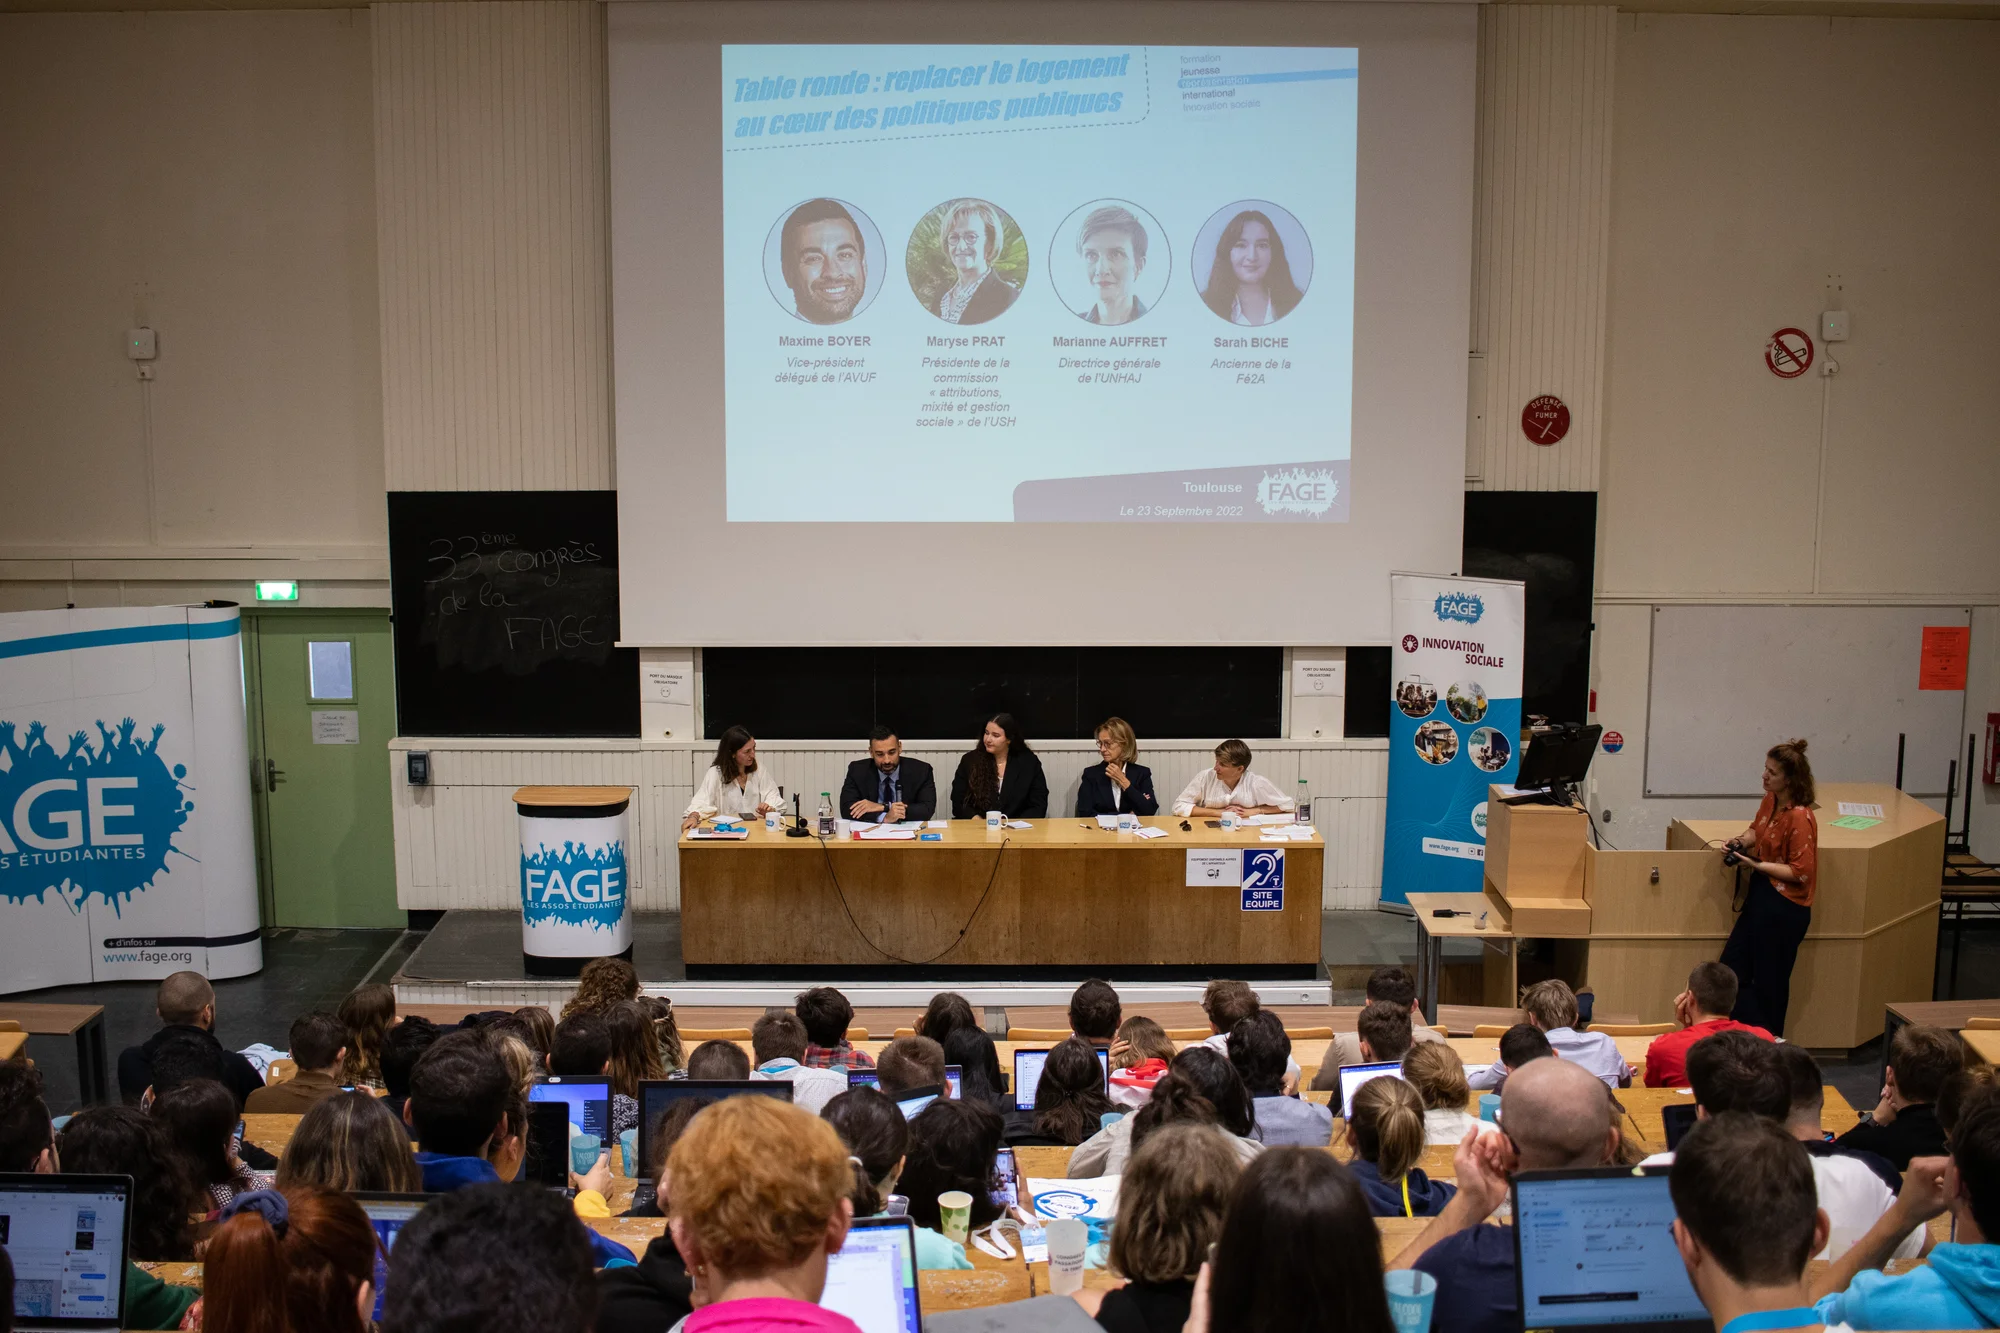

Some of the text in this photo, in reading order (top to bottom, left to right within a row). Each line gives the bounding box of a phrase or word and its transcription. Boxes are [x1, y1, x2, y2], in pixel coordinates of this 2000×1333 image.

[1180, 53, 1221, 64] formation
[734, 75, 797, 103] Table
[800, 70, 870, 98] ronde
[884, 64, 987, 93] replacer
[989, 61, 1013, 85] le
[1016, 53, 1130, 84] logement
[1180, 67, 1220, 78] jeunesse
[1182, 89, 1236, 100] international
[1230, 100, 1261, 110] sociale
[734, 91, 1124, 138] au cœur des politiques publiques
[779, 336, 872, 346] Maxime BOYER
[927, 336, 1005, 349] Maryse PRAT
[1053, 336, 1167, 347] Marianne AUFFRET
[1213, 337, 1289, 348] Sarah BICHE
[787, 357, 865, 370] Vice-président
[921, 357, 1010, 368] Présidente de la
[1058, 357, 1161, 371] Directrice générale
[1210, 358, 1292, 369] Ancienne de la
[774, 372, 877, 385] délégué de l'AVUF
[933, 373, 998, 383] commission
[1077, 373, 1142, 384] de l'UNHAJ
[1235, 373, 1266, 384] Fé2A
[939, 387, 1002, 399] attributions,
[921, 401, 1010, 414] mixité et gestion
[1531, 397, 1562, 410] DEFENSE
[916, 416, 954, 427] sociale
[967, 417, 981, 427] de
[984, 416, 1017, 427] l'USH
[1183, 481, 1327, 501] Toulouse FAGE
[1120, 505, 1243, 518] Le 23 Septembre 2022
[440, 581, 518, 615] de la
[1440, 600, 1478, 617] FAGE
[503, 615, 606, 651] FAGE
[1422, 637, 1484, 654] INNOVATION
[1465, 653, 1504, 668] SOCIALE
[1428, 843, 1460, 854] www.fage.org
[19, 847, 146, 867] ÉTUDIANTES
[525, 867, 622, 904] FAGE
[1252, 891, 1273, 900] SITE
[541, 902, 570, 910] ASSOS
[573, 900, 622, 910] ÉTUDIANTES
[1245, 900, 1280, 909] EQUIPE
[116, 938, 143, 947] d'infos
[103, 950, 192, 965] www.fage.org
